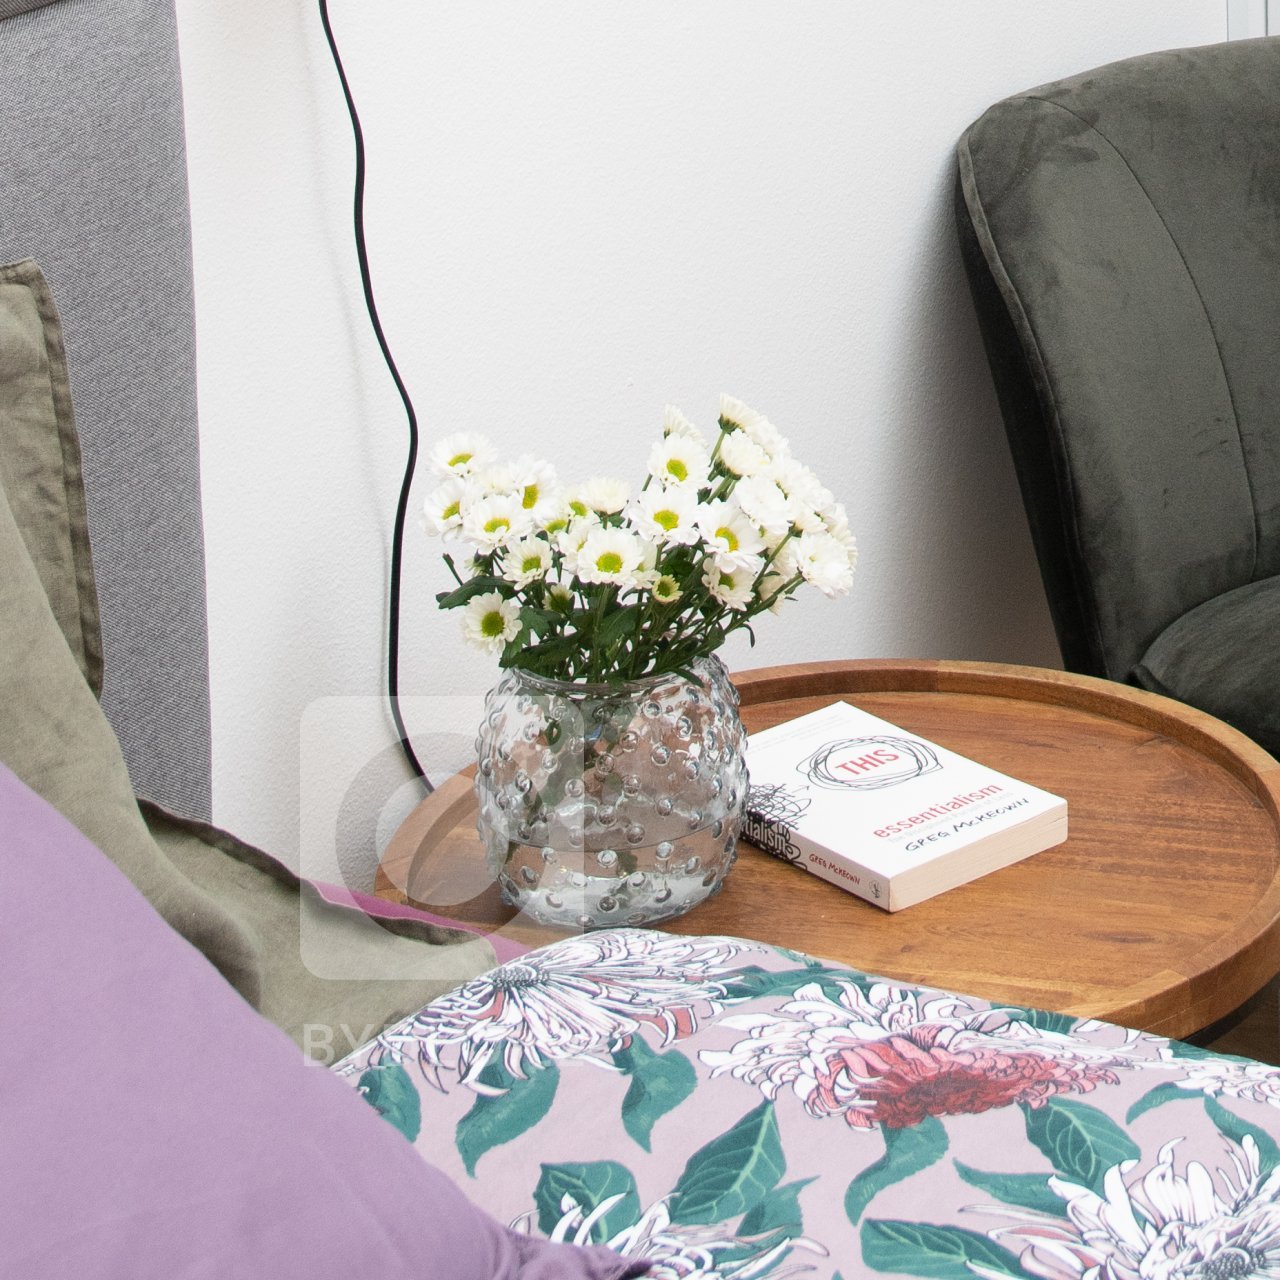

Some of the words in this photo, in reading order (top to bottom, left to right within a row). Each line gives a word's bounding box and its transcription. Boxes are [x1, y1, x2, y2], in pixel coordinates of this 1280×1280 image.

[834, 748, 900, 776] THIS
[872, 782, 1004, 840] essentialism
[904, 831, 950, 853] GREG
[952, 797, 1030, 832] McKEOWN
[808, 853, 828, 870] GREG
